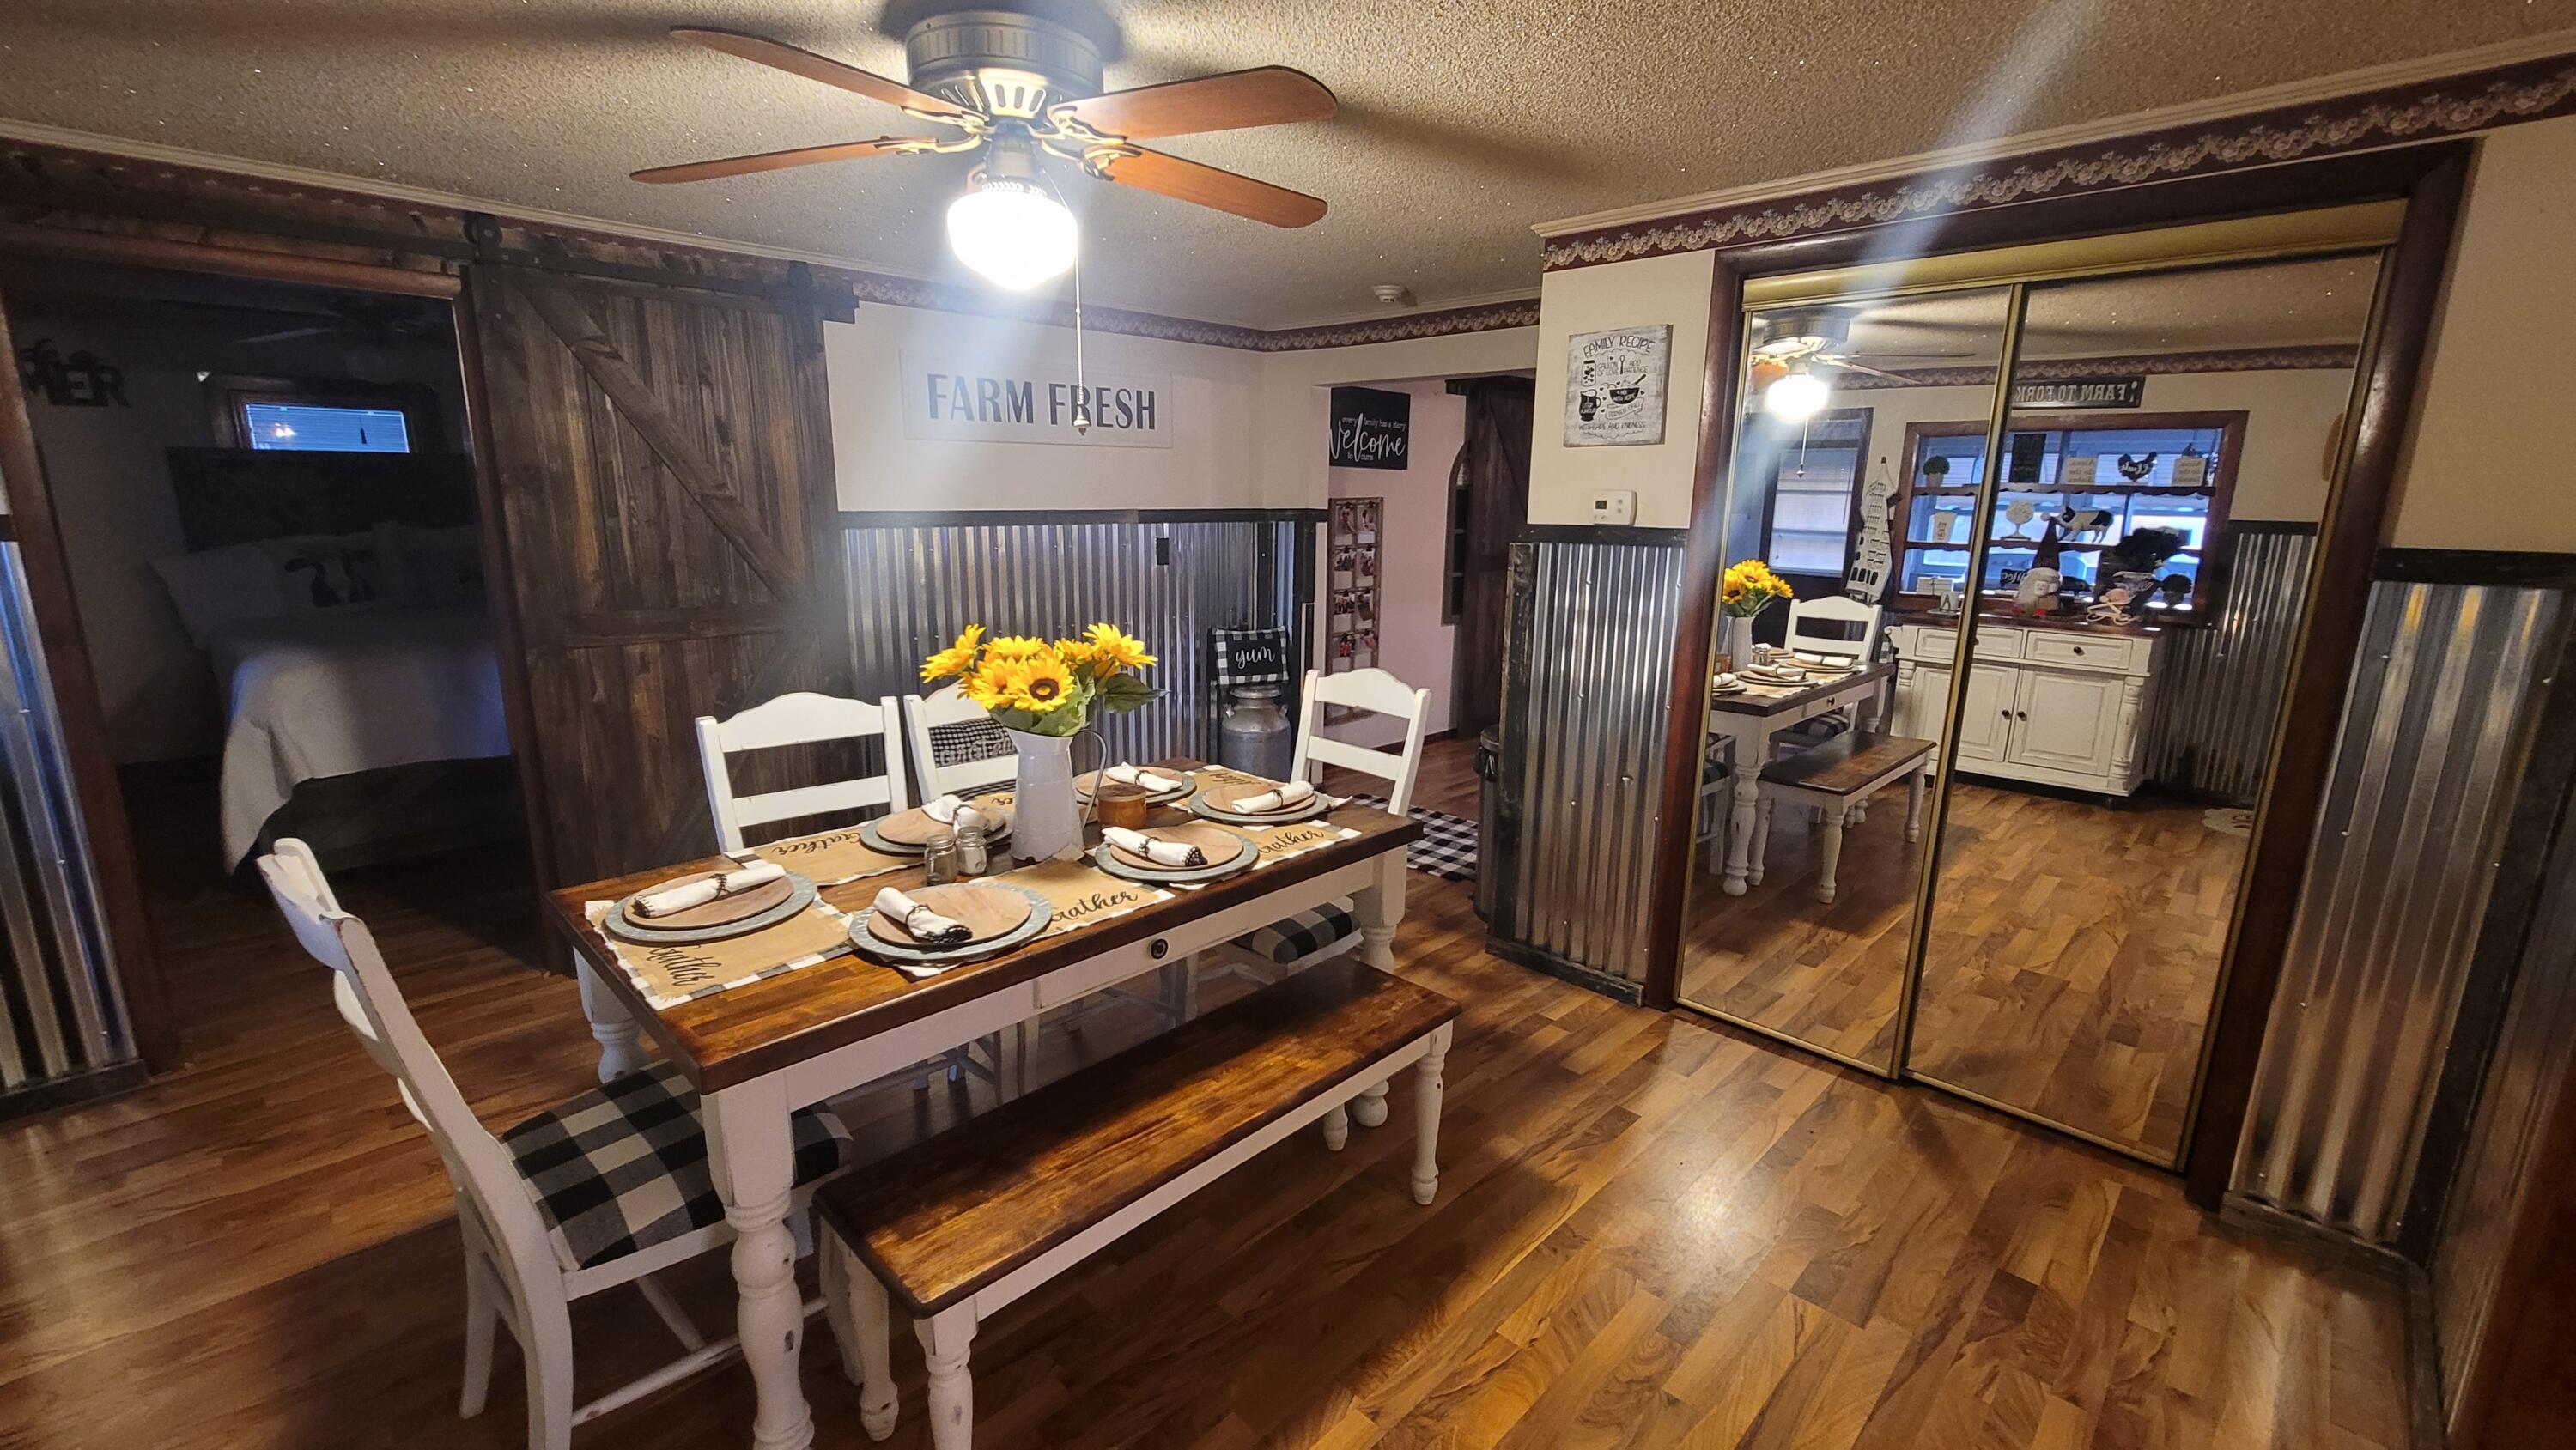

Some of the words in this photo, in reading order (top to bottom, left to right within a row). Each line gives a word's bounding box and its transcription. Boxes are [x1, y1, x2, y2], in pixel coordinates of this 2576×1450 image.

[1583, 336, 1616, 357] FAMILY
[1619, 336, 1656, 354] RECIPE
[927, 373, 1035, 424] FARM
[1048, 383, 1155, 430] FRESH
[1236, 646, 1276, 670] yum
